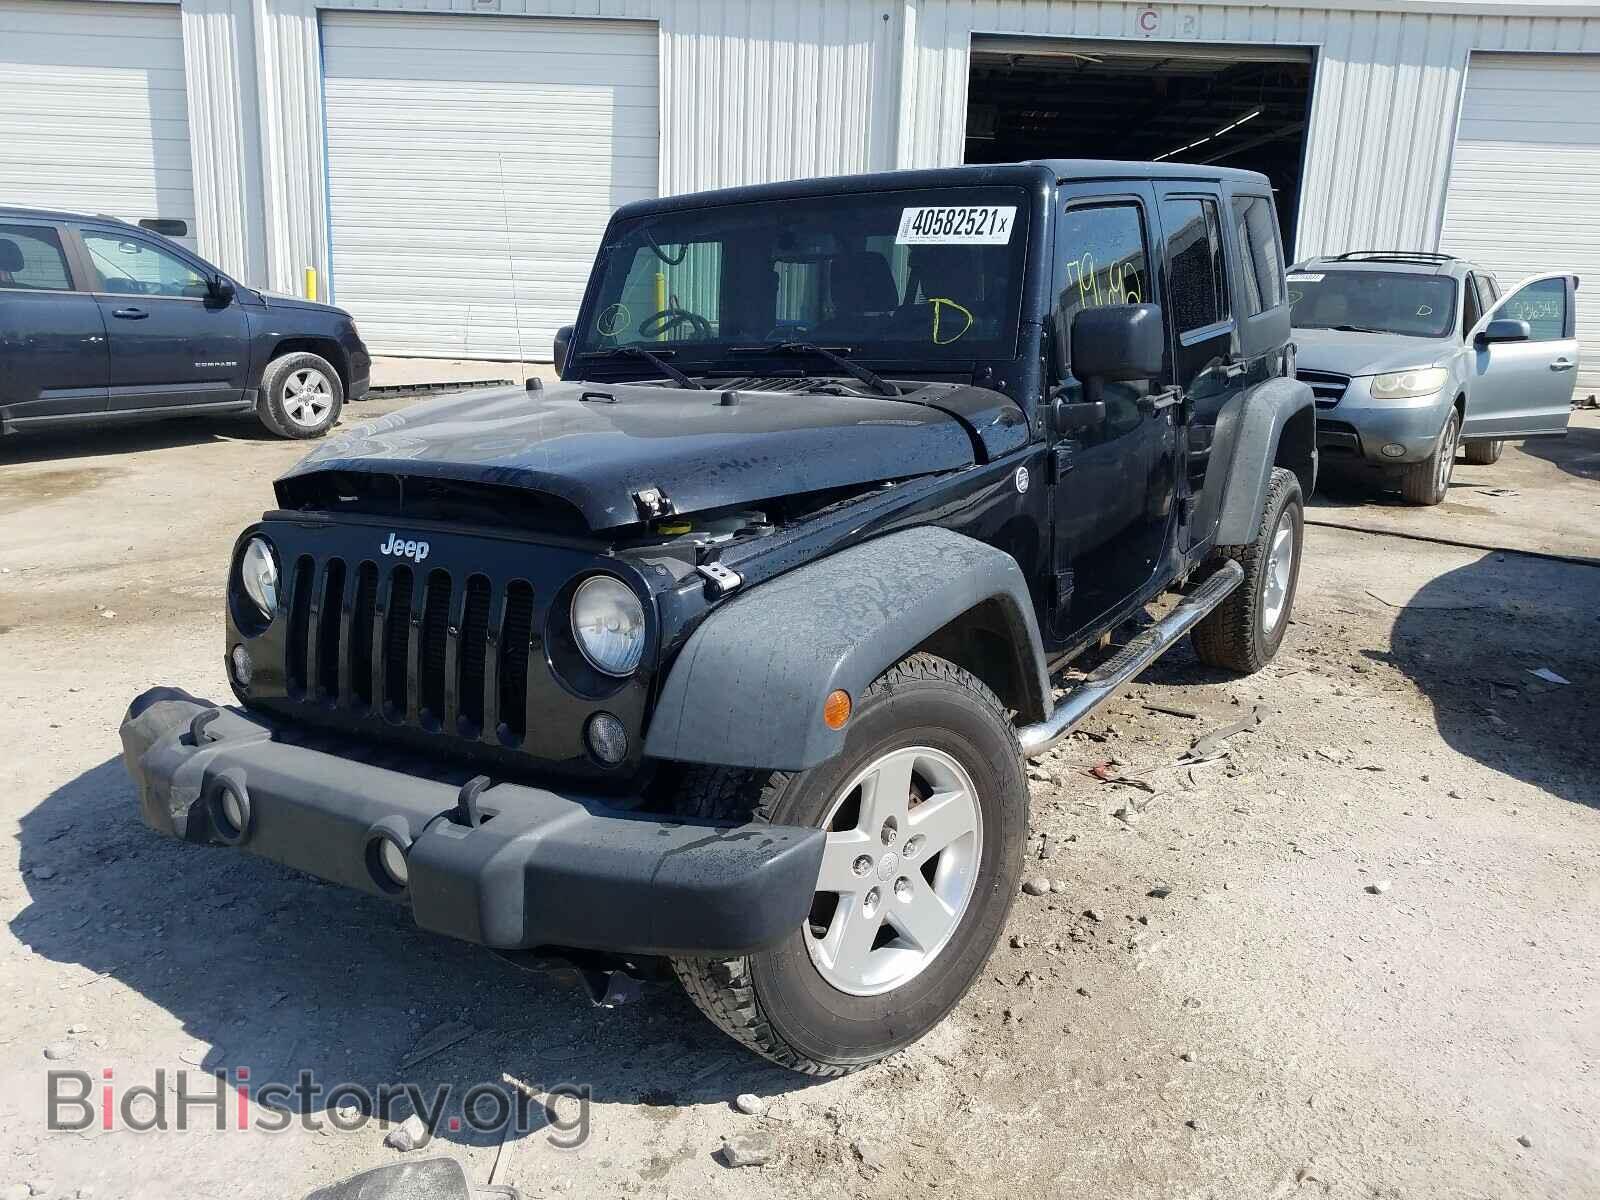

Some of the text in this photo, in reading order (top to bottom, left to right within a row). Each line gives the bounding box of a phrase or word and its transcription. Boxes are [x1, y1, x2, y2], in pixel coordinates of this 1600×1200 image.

[1140, 11, 1158, 31] C
[912, 208, 999, 236] 40582521
[928, 298, 974, 344] D
[380, 532, 430, 563] Jeep
